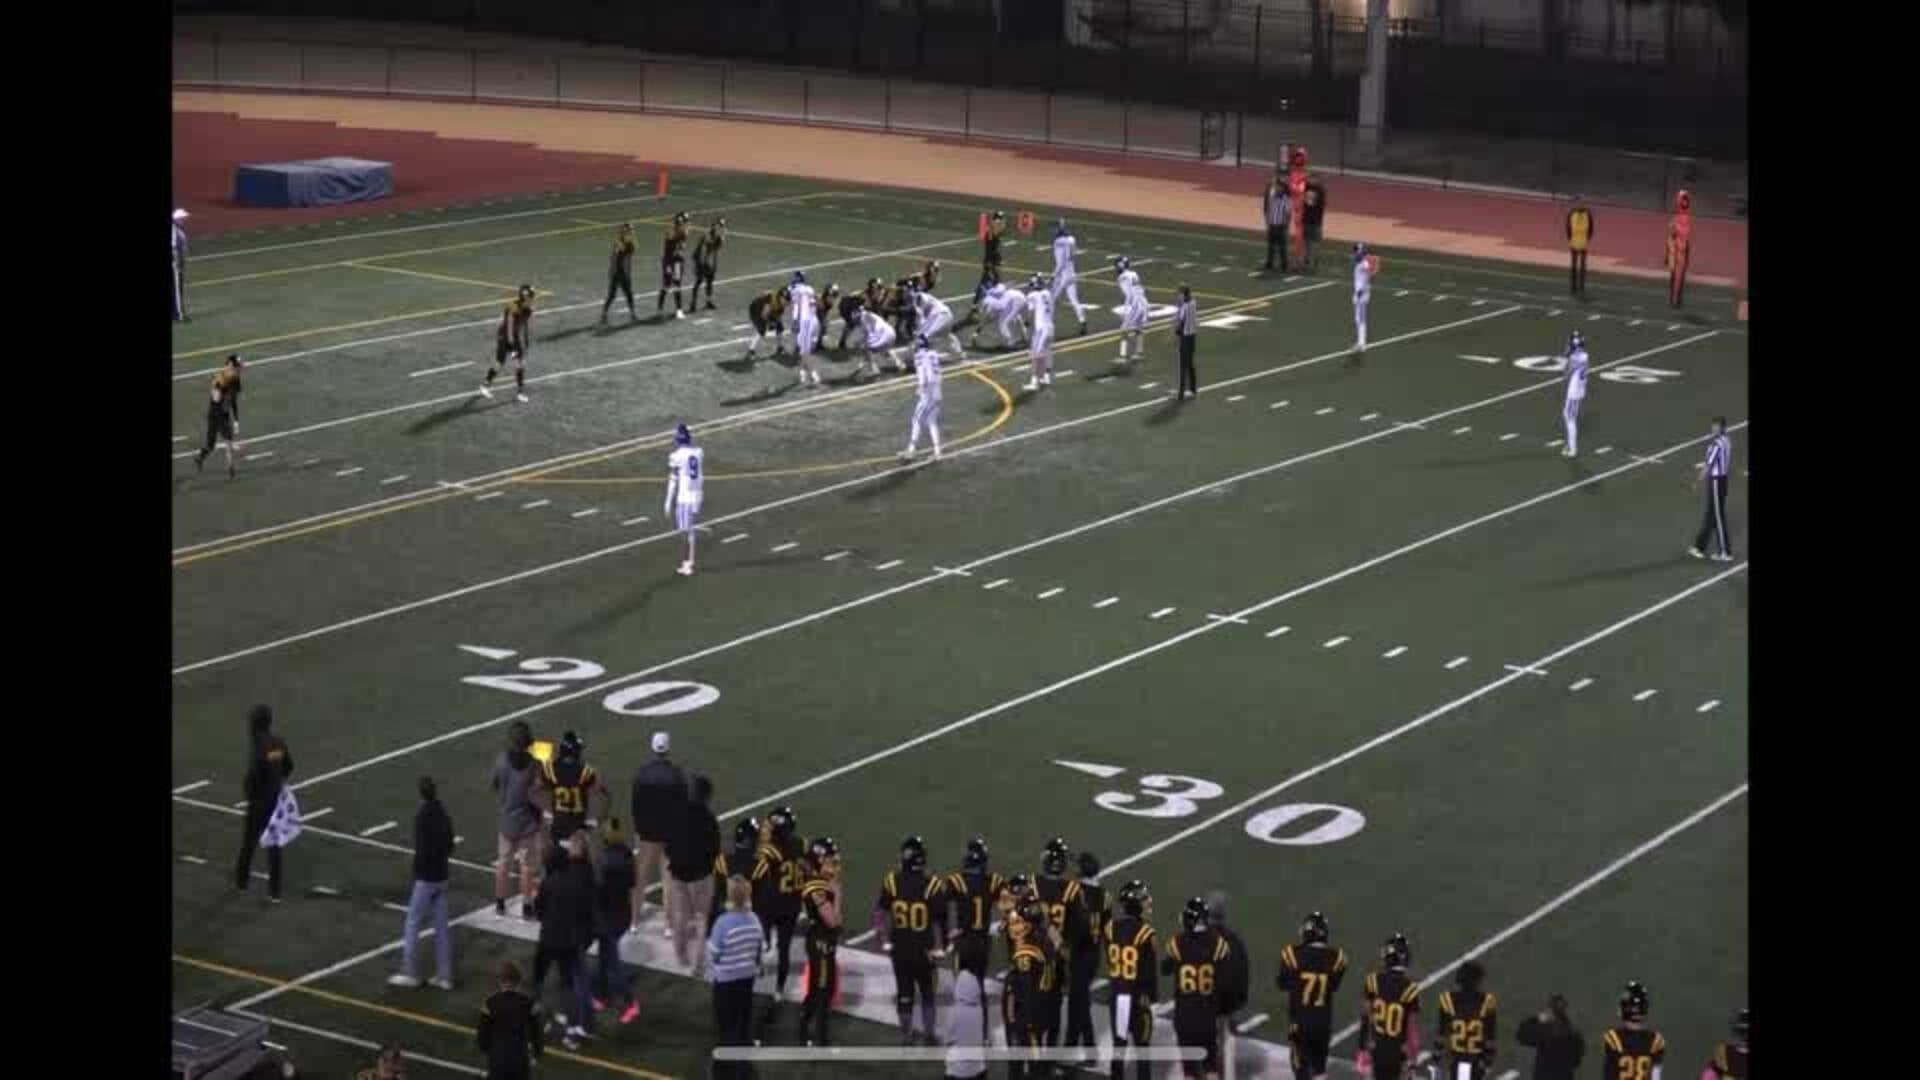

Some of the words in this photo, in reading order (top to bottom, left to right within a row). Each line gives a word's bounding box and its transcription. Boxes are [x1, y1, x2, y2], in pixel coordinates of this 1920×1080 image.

[689, 455, 699, 480] 9
[460, 657, 719, 716] 20
[554, 786, 584, 813] 21
[1092, 774, 1363, 845] 30
[892, 900, 928, 931] 60
[970, 896, 982, 930] 1
[1179, 963, 1214, 994] 66
[1300, 972, 1328, 1006] 71
[1374, 999, 1403, 1037] 20
[1451, 1019, 1482, 1053] 22
